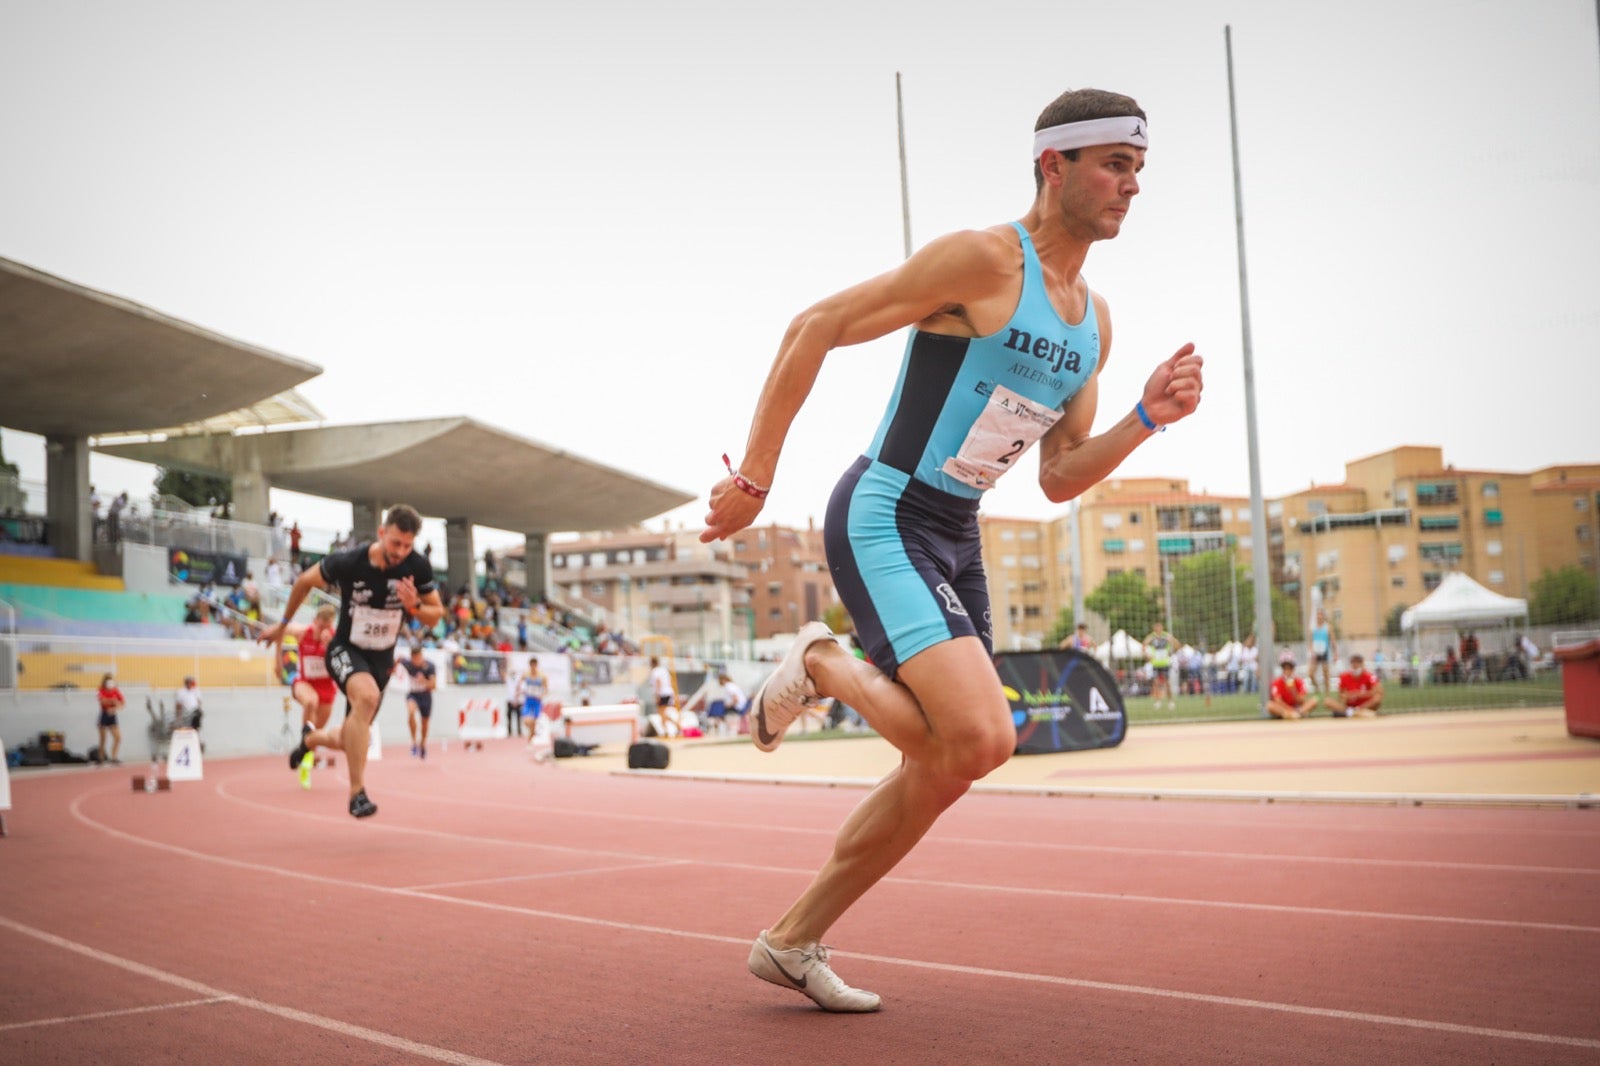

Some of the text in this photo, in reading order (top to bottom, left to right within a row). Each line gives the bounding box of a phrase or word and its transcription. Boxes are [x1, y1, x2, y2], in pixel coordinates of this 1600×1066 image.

[1003, 327, 1081, 374] nerja
[1008, 362, 1063, 391] ATLETISMO
[996, 439, 1025, 465] 2
[175, 745, 191, 767] 4
